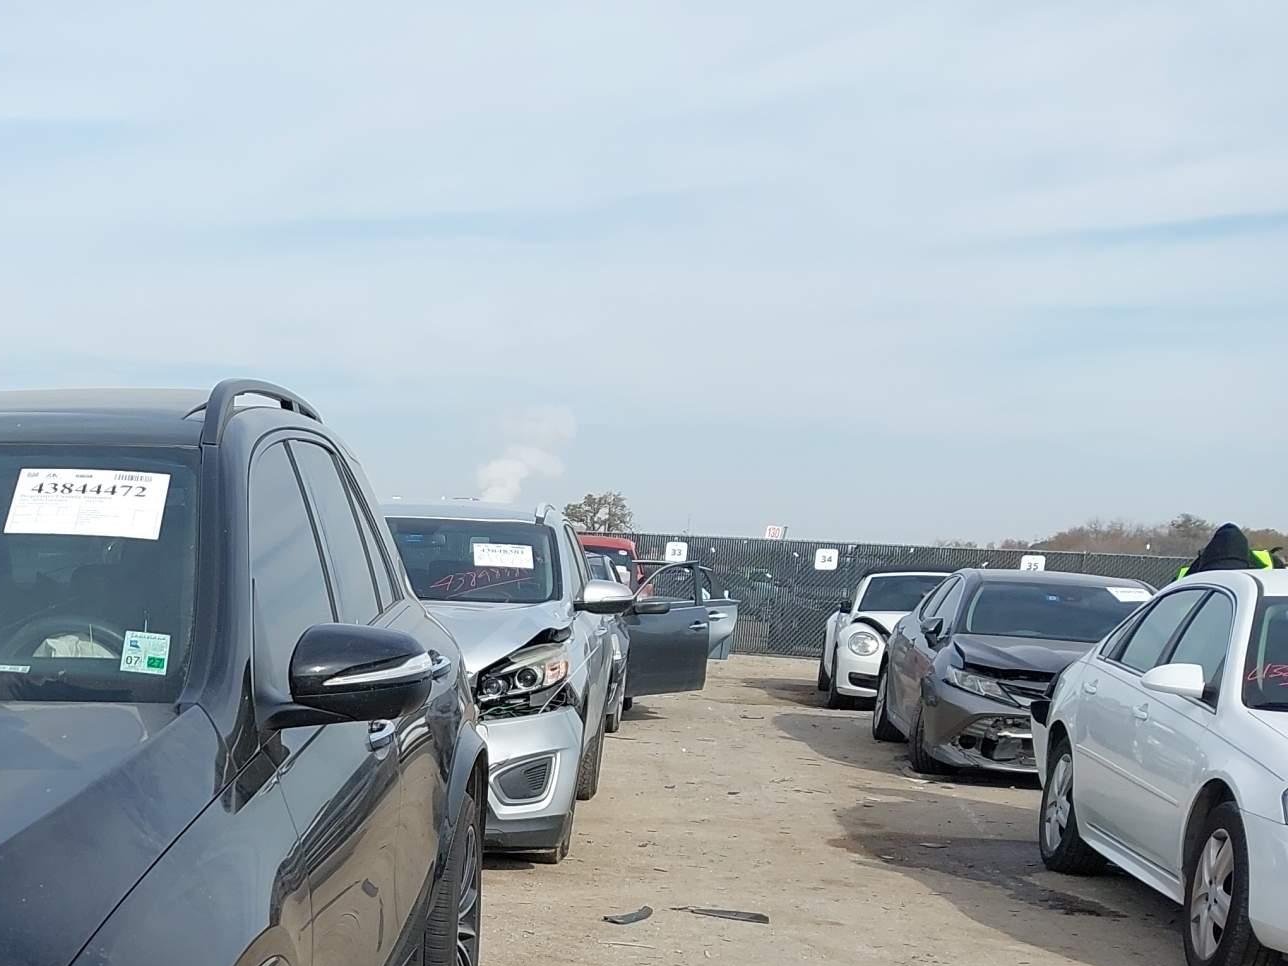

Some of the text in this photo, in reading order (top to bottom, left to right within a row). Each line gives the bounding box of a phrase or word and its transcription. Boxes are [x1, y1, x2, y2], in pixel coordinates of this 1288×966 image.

[31, 482, 148, 498] 43844472
[767, 527, 780, 539] 130
[671, 548, 682, 557] 33
[820, 555, 833, 564] 34
[1026, 562, 1039, 571] 35
[125, 655, 141, 666] 07
[148, 656, 164, 668] 27
